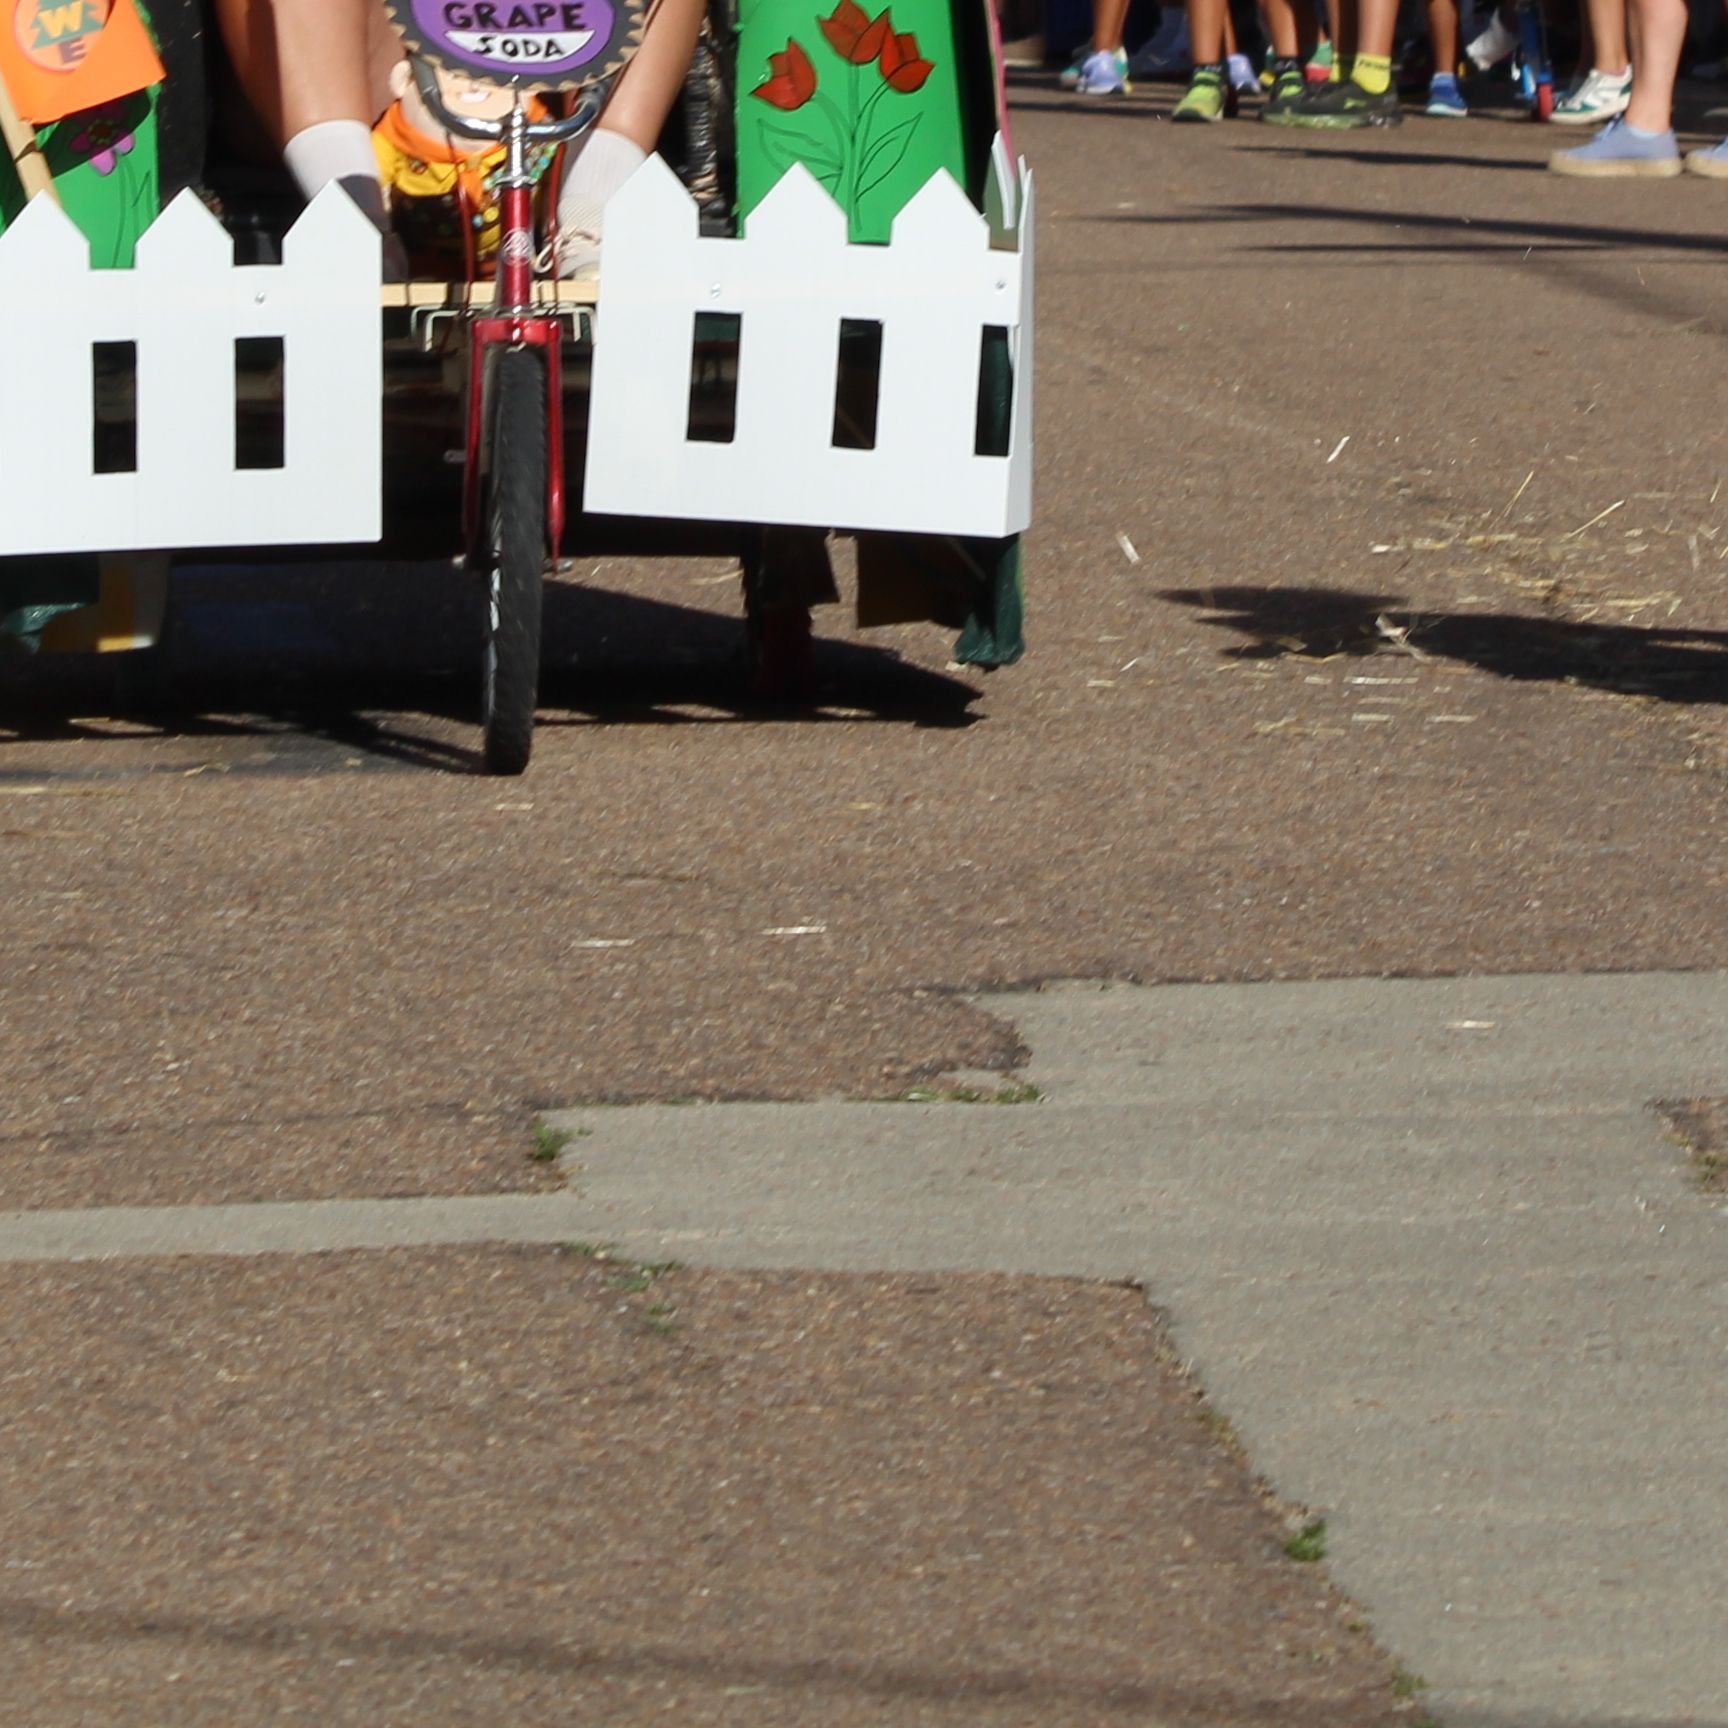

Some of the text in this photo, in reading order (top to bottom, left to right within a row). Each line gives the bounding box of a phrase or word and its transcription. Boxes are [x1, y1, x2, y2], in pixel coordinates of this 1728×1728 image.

[38, 0, 84, 39] W
[443, 2, 587, 31] GRAPE
[472, 35, 565, 58] SODA
